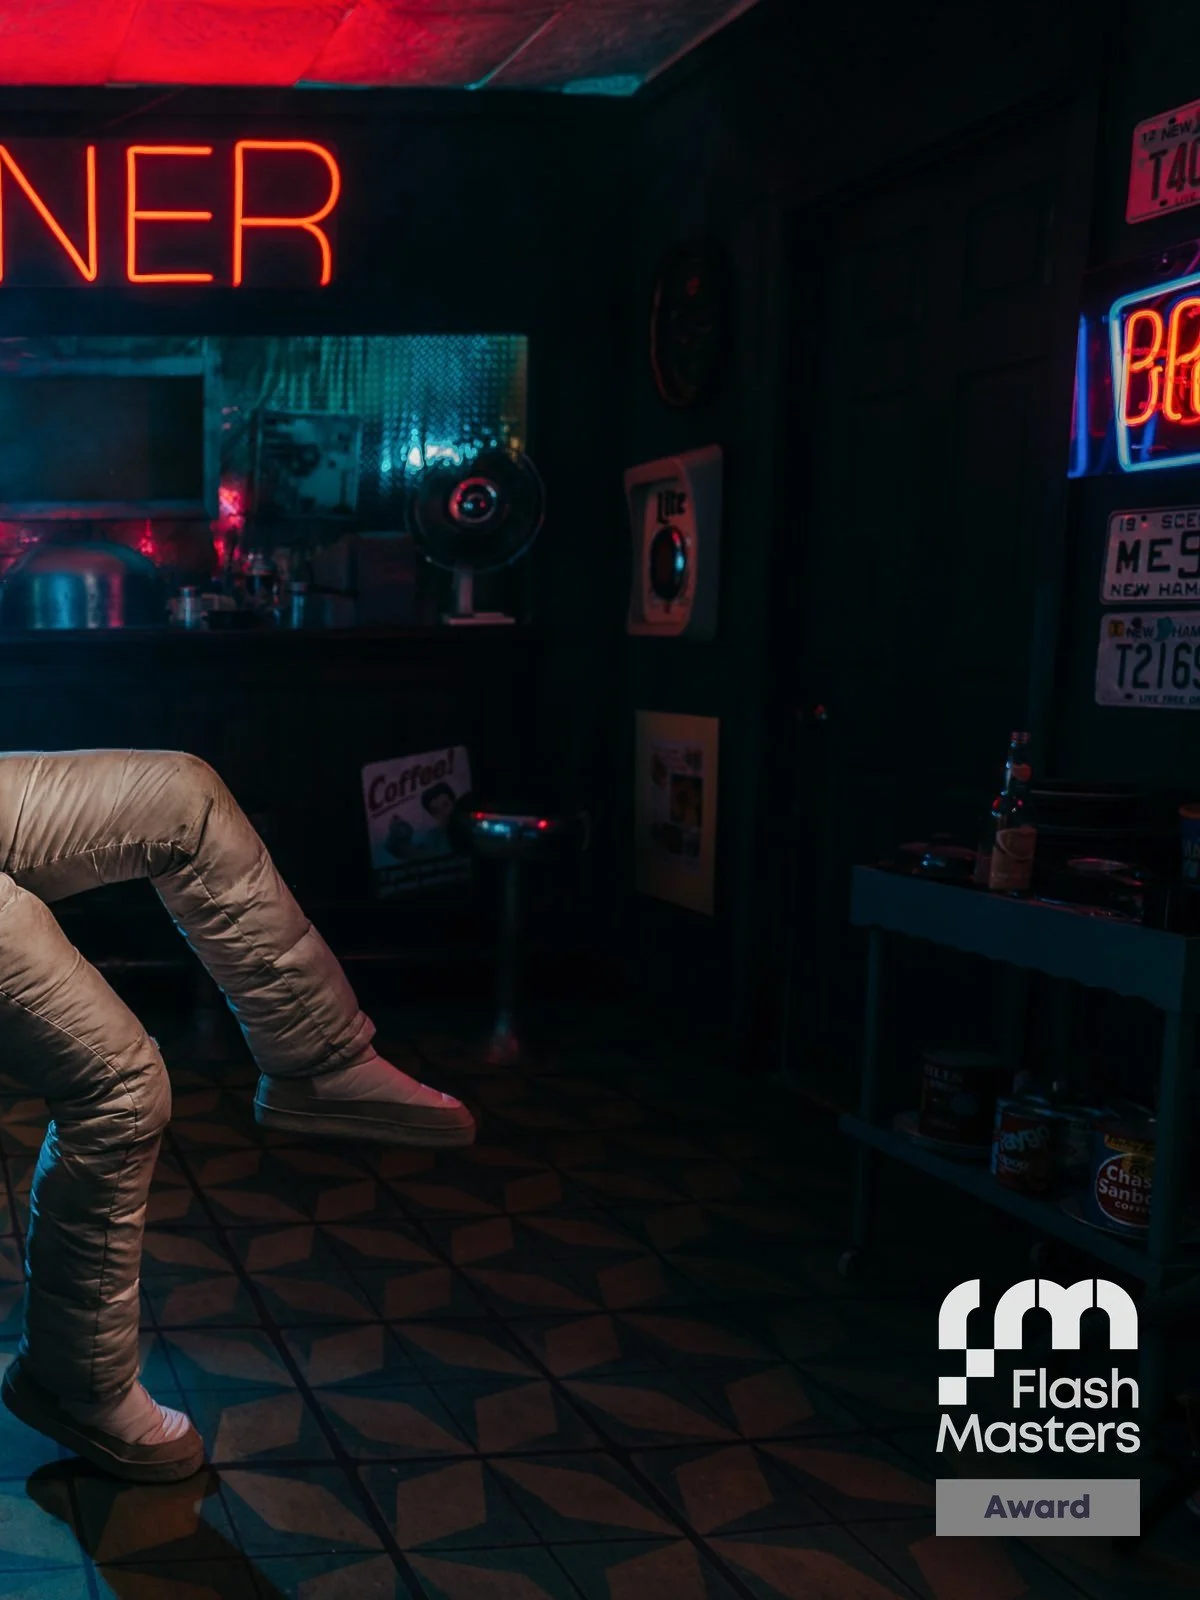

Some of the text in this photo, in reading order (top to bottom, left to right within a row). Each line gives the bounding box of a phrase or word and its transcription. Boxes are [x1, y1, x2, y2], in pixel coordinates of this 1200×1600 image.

[657, 490, 687, 524] Lite
[1161, 513, 1200, 529] SCE
[1111, 582, 1200, 597] NEW HAM
